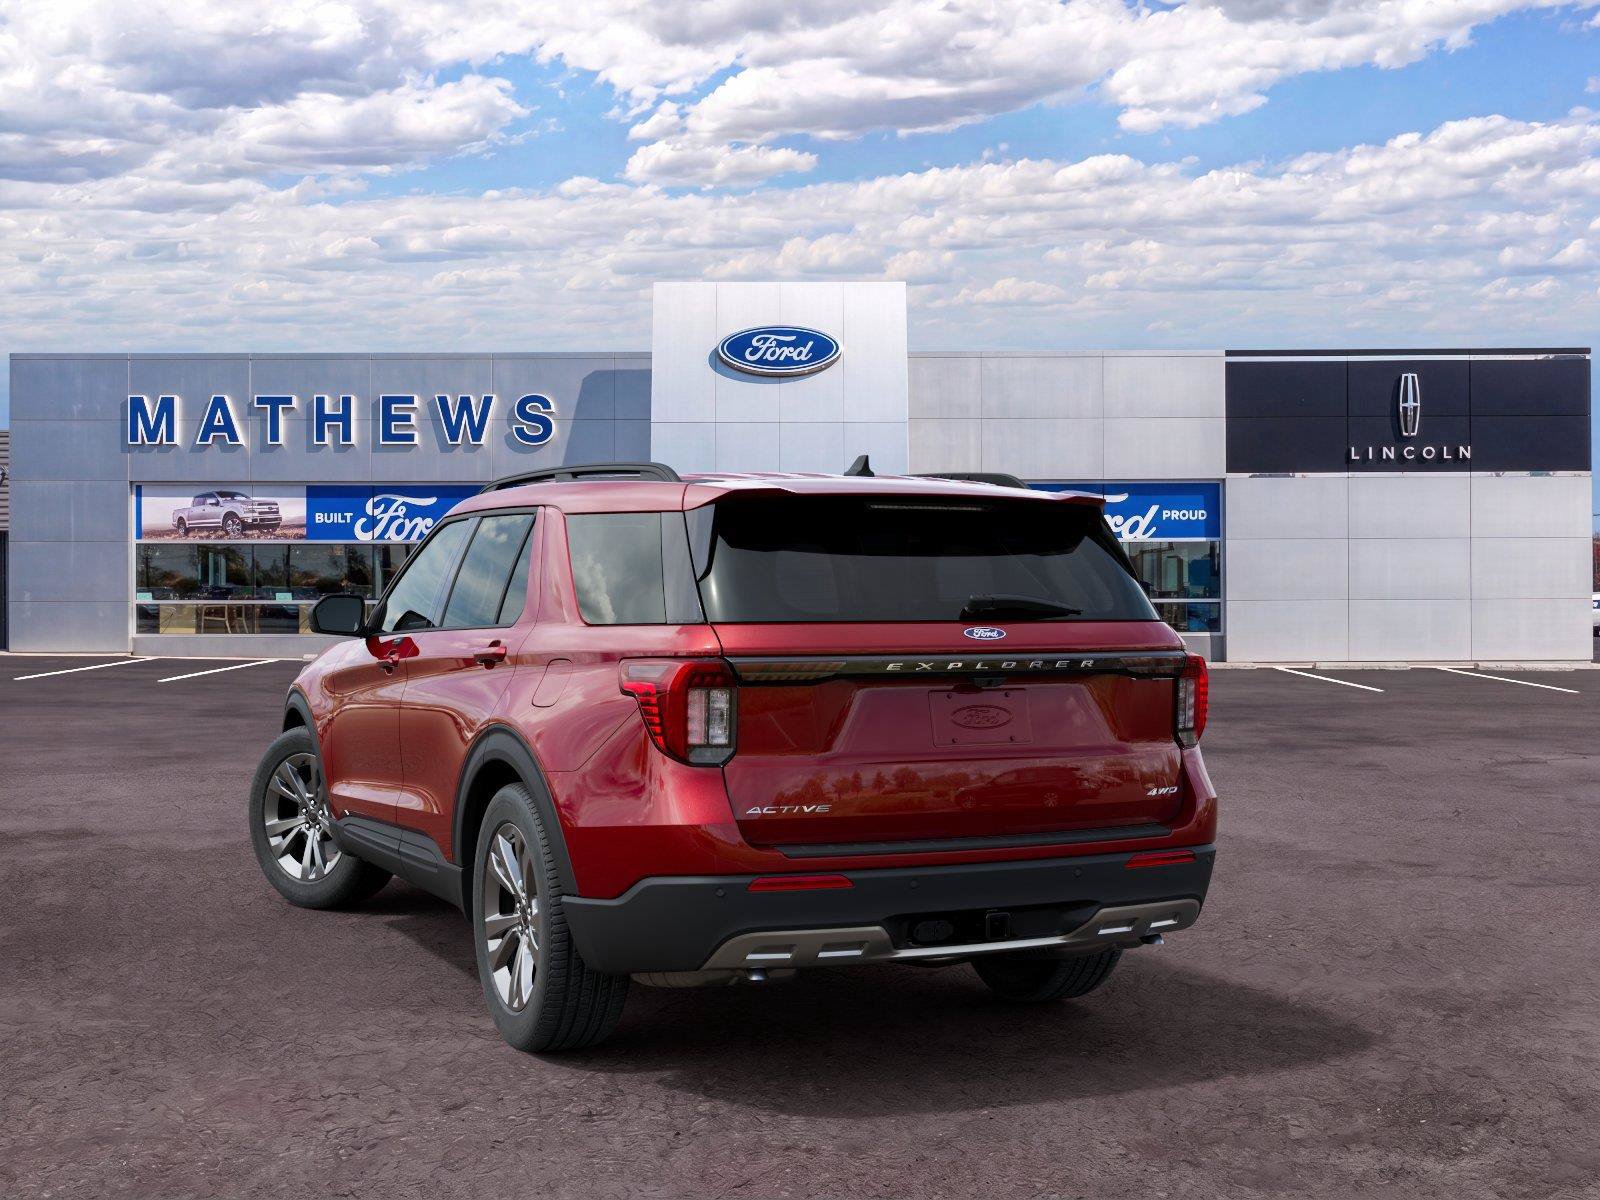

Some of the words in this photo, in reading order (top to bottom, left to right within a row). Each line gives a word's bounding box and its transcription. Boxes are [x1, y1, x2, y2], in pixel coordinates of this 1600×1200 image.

[745, 334, 814, 361] Ford
[128, 394, 556, 445] MATHEWS
[1351, 446, 1471, 460] LINCOLN
[315, 512, 353, 524] BUILT
[354, 494, 438, 540] For
[1078, 490, 1159, 539] rd
[1162, 509, 1207, 521] PROUD
[886, 659, 1095, 671] EXPLORER
[1147, 786, 1178, 796] 4WD
[745, 804, 832, 814] ACTIVE
